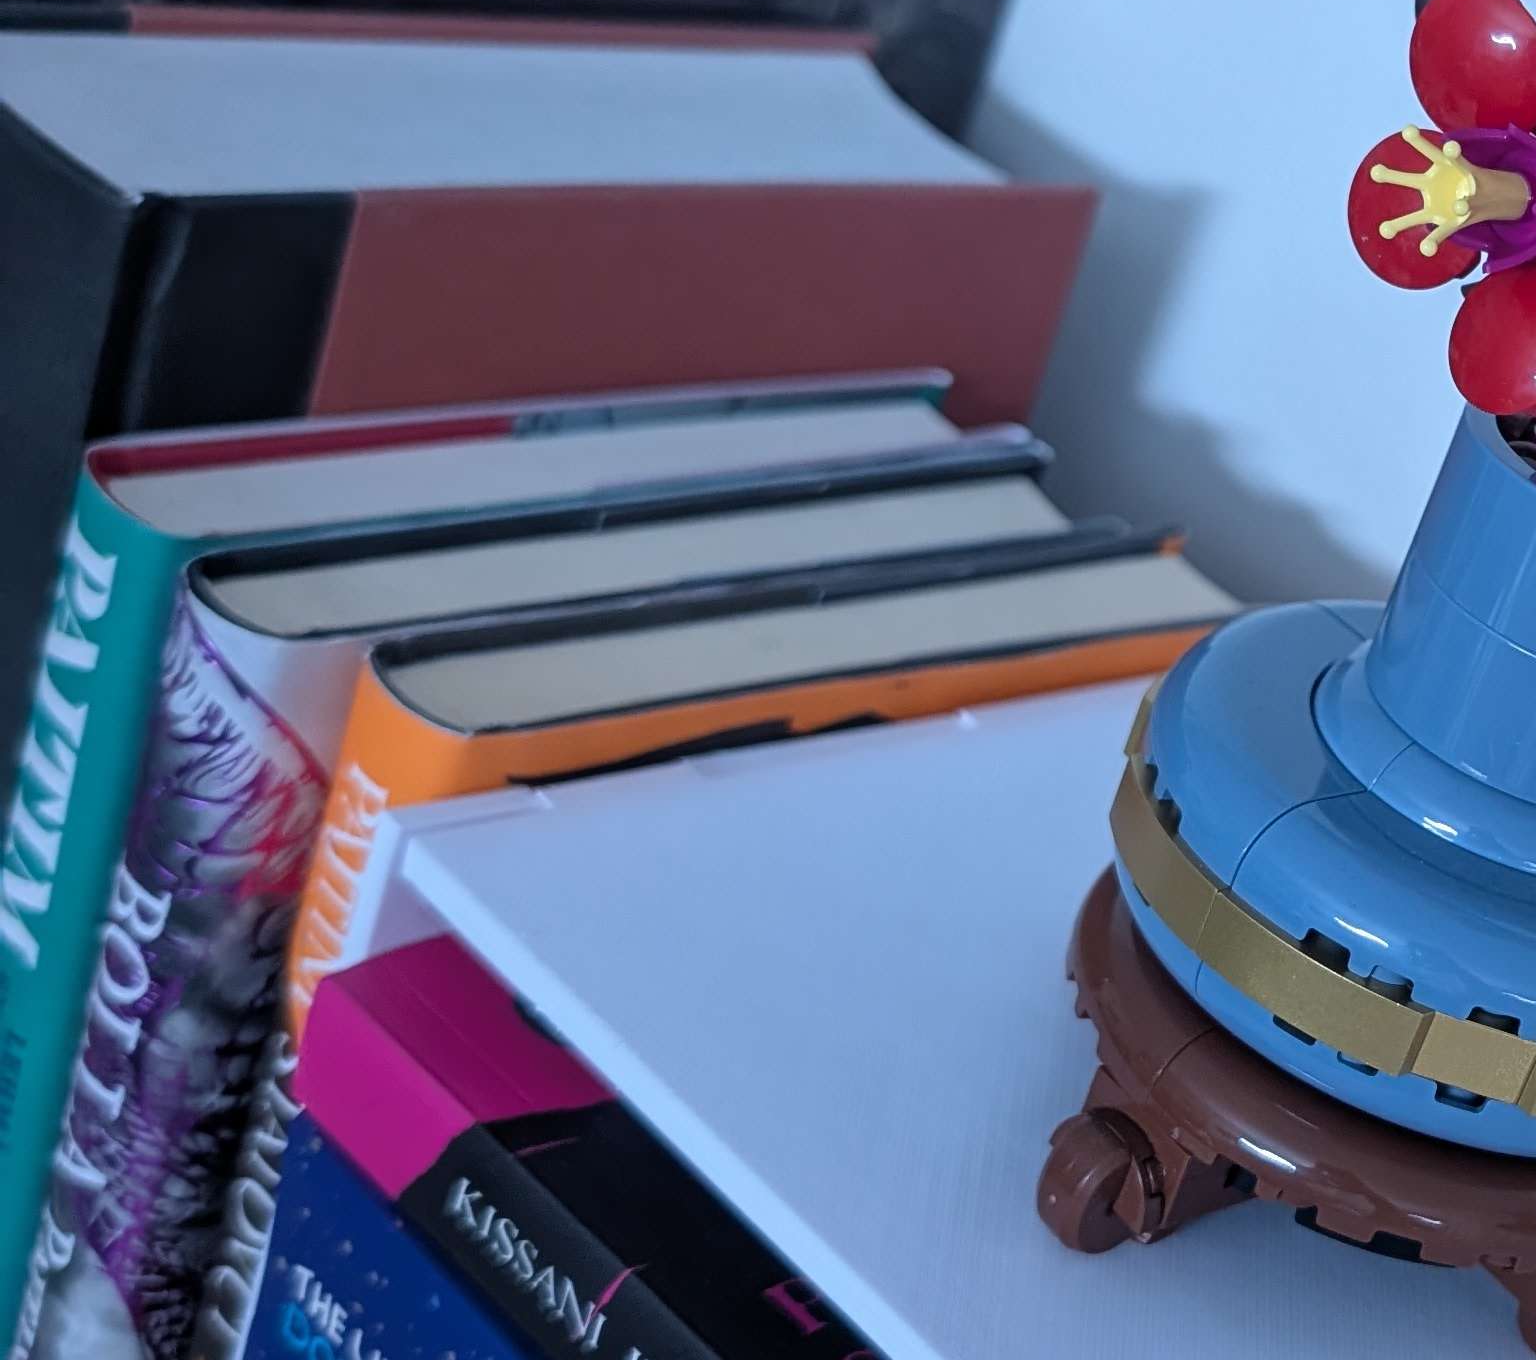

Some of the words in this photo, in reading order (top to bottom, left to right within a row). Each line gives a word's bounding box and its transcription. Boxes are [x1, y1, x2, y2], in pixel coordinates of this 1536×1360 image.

[52, 862, 171, 1190] BOLLA
[289, 1264, 345, 1343] THE
[444, 1176, 608, 1353] KISSANI
